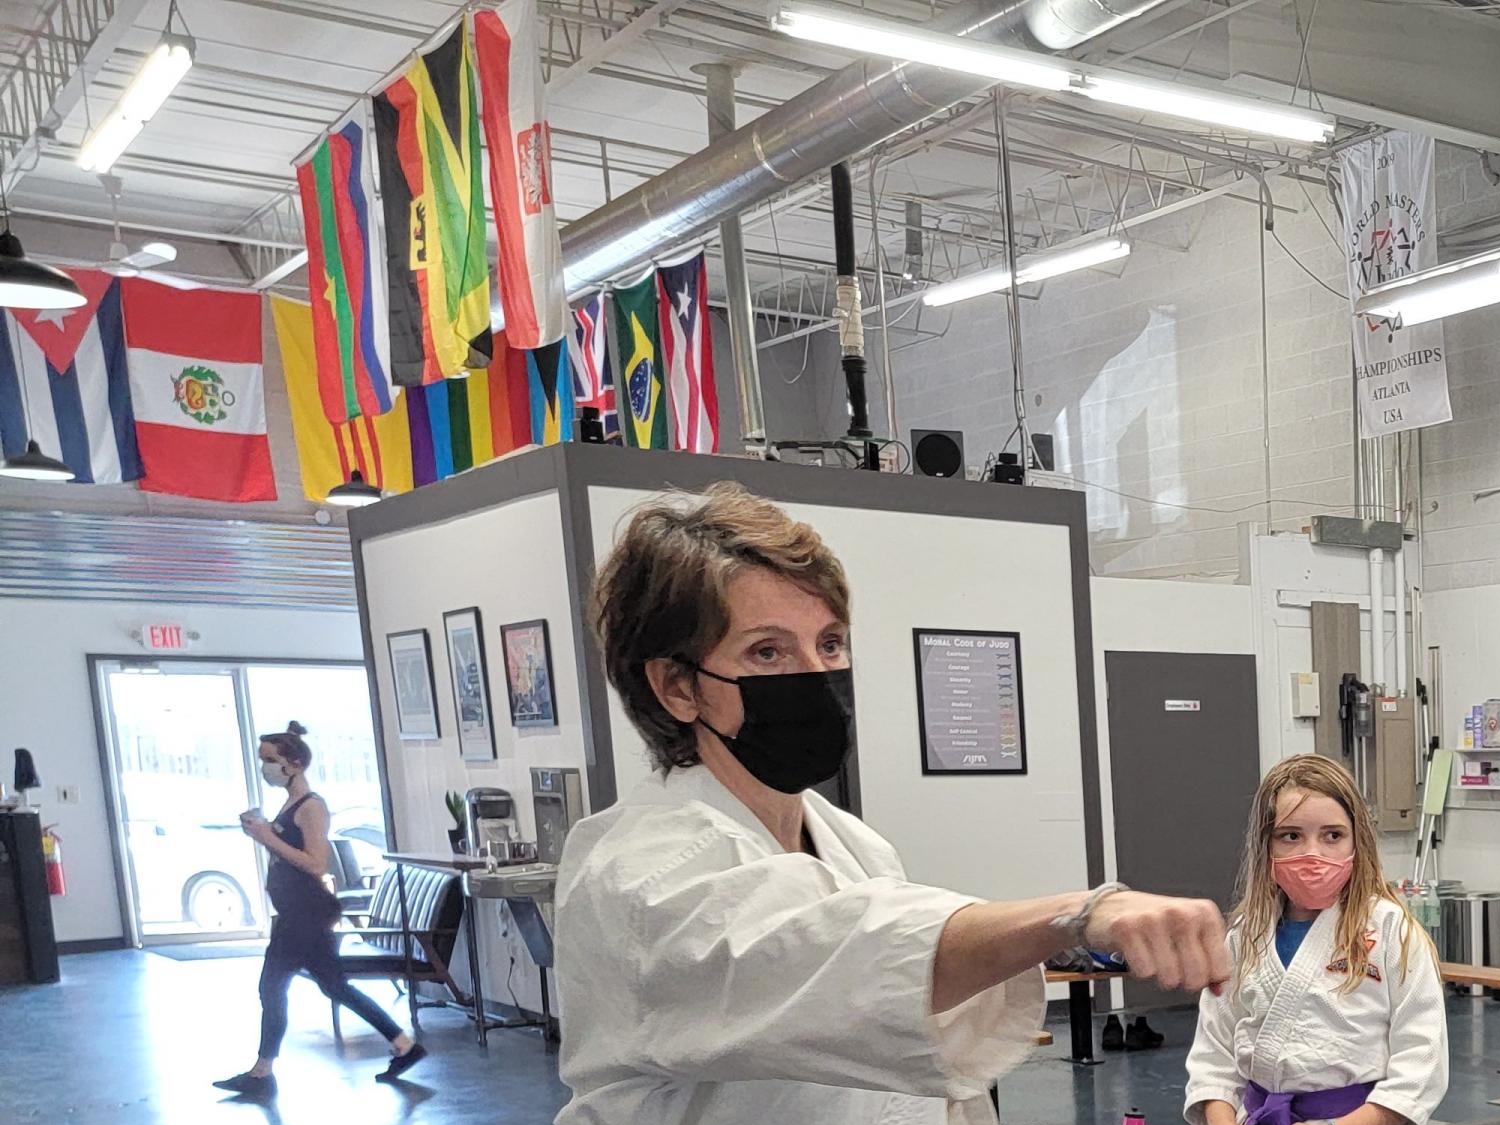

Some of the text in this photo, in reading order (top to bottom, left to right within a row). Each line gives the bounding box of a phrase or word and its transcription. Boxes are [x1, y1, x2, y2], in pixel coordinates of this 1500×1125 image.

[1385, 192, 1426, 242] MASTERS
[1356, 347, 1442, 380] HAMPIONSHIPS
[1372, 380, 1411, 401] ATLANTA
[1384, 408, 1403, 424] USA
[150, 626, 181, 649] EXIT
[989, 641, 1010, 649] JUDO
